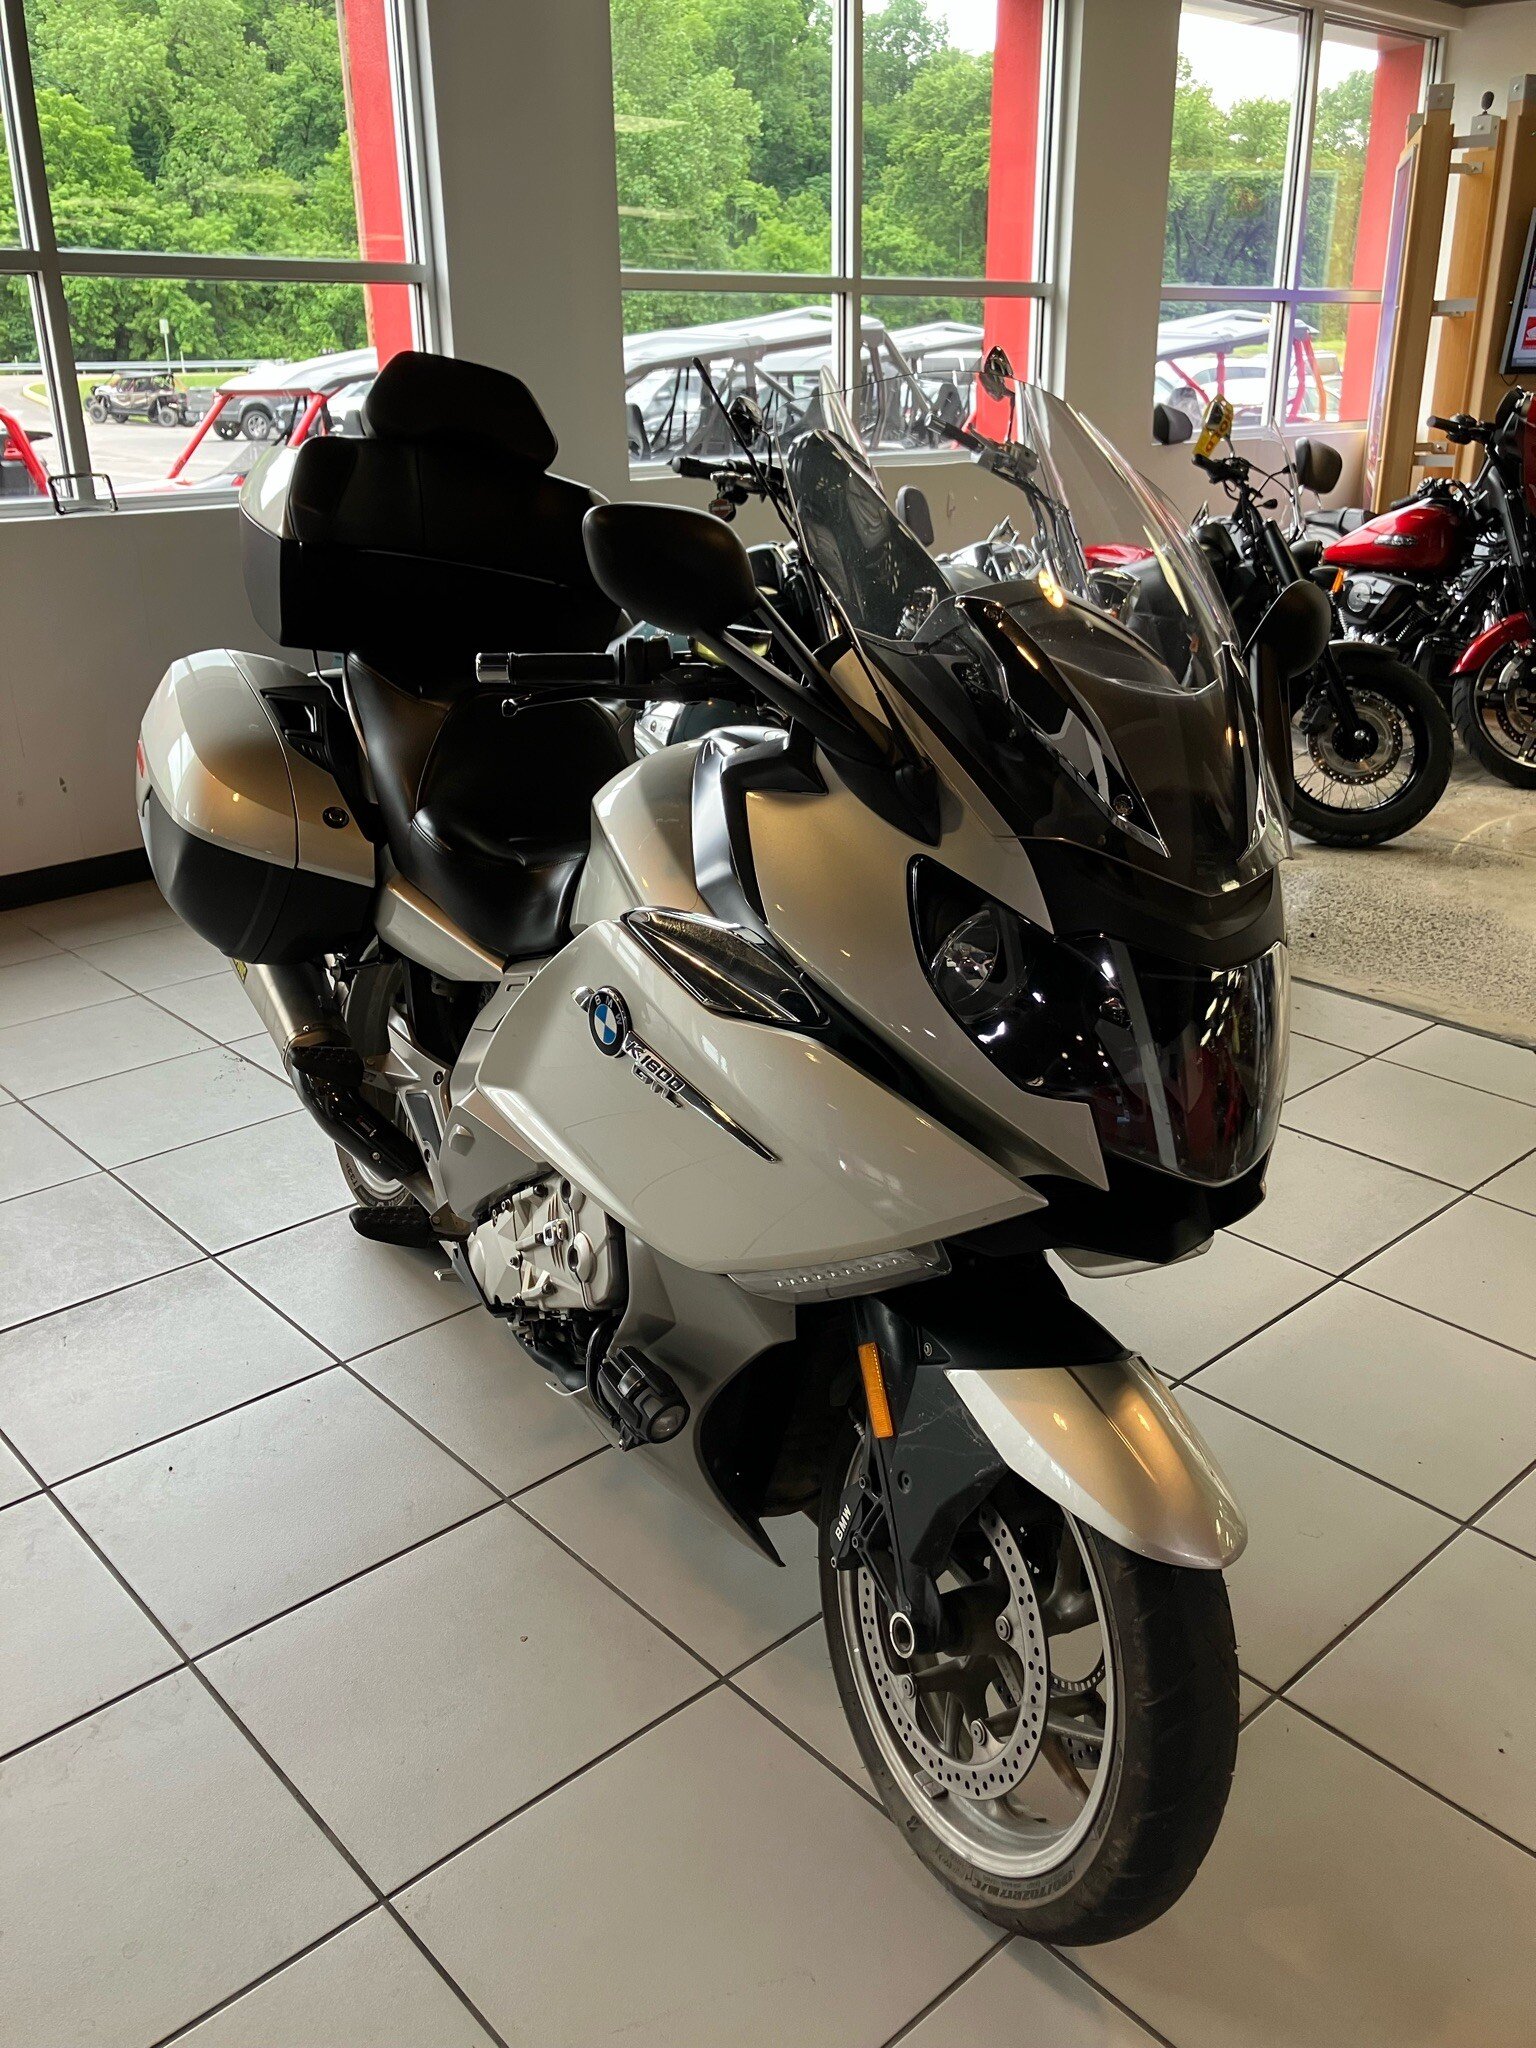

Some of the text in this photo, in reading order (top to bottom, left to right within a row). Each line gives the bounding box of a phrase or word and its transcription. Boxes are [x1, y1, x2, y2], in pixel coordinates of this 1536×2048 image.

[594, 994, 622, 1025] BMW
[631, 1062, 683, 1109] GTL
[835, 1503, 852, 1542] BMW
